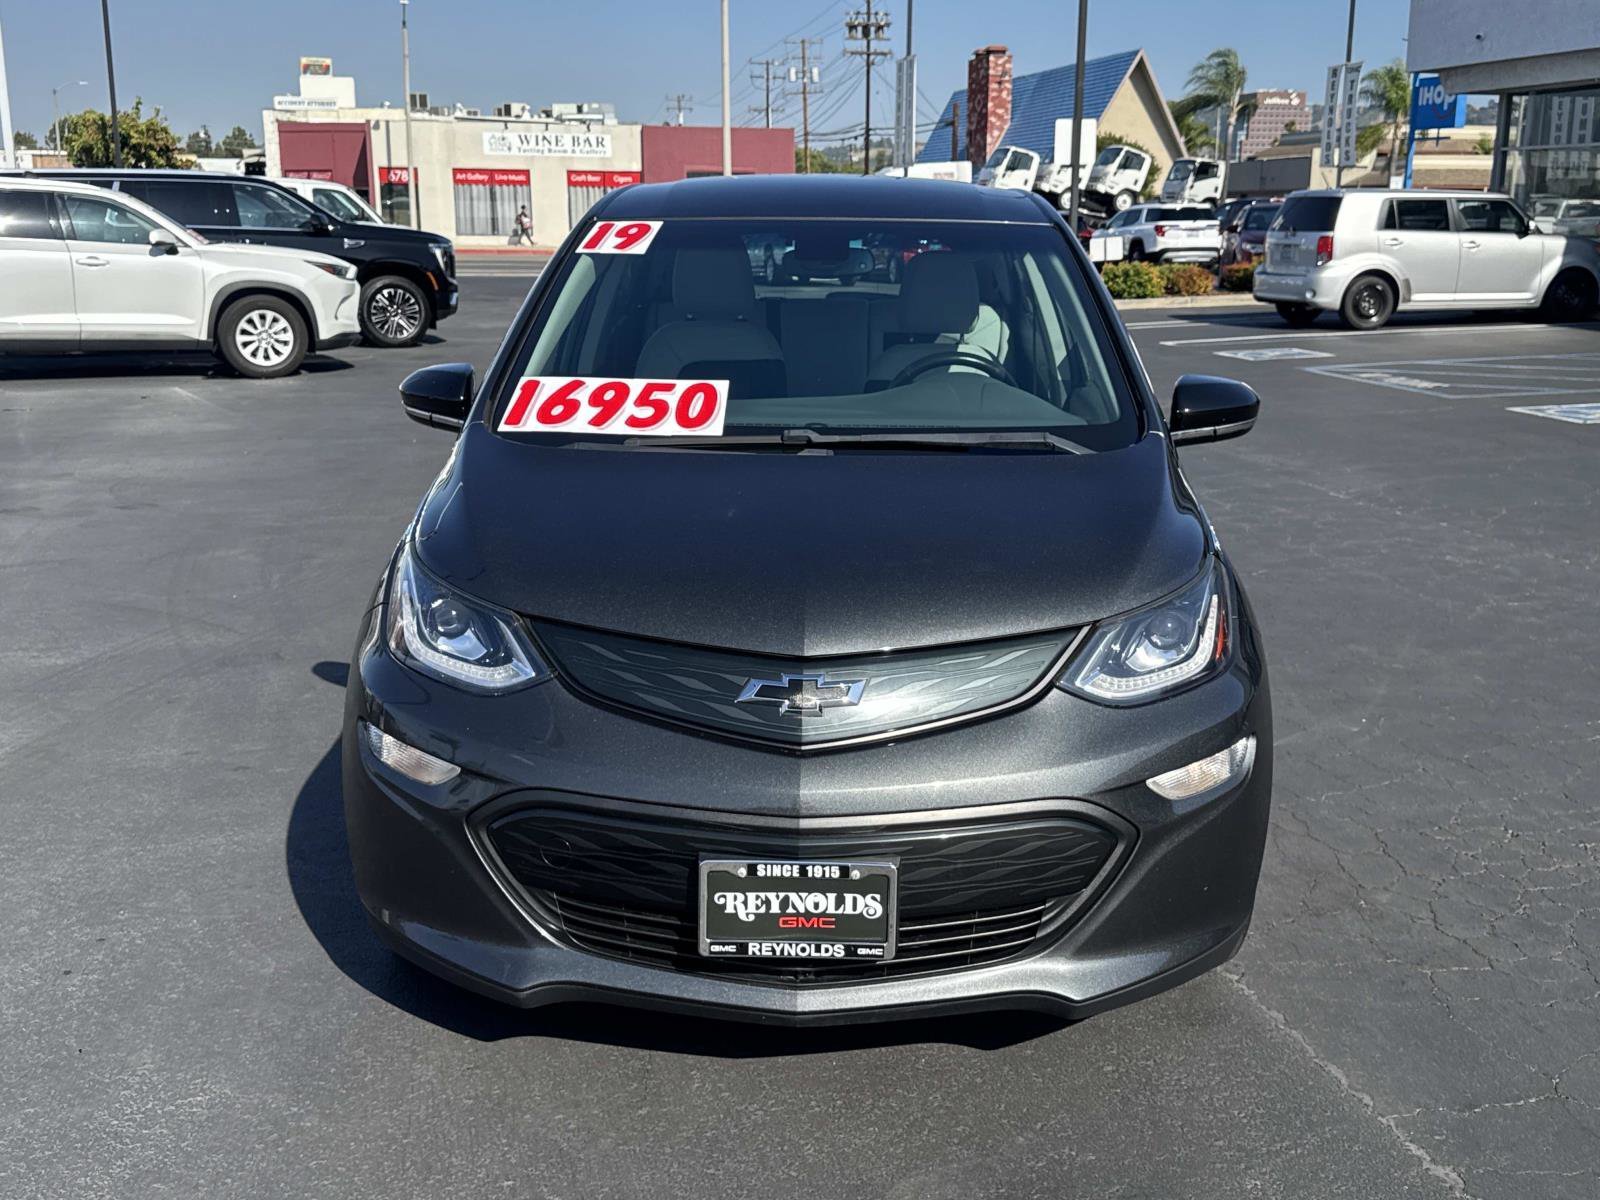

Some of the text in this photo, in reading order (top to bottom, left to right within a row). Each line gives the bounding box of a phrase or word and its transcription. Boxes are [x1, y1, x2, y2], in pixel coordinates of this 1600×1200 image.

[1418, 84, 1457, 110] IHOP
[1324, 67, 1339, 165] REYNOLDS
[1343, 79, 1355, 161] TRUCKS
[518, 134, 606, 149] WINE BAR
[582, 222, 652, 250] 19
[504, 379, 721, 430] 16950
[756, 864, 840, 878] SINCE 1915
[714, 892, 883, 921] REYNOLDS
[779, 917, 836, 928] GMC
[748, 942, 845, 957] REYNOLDS
[857, 947, 884, 955] GMC
